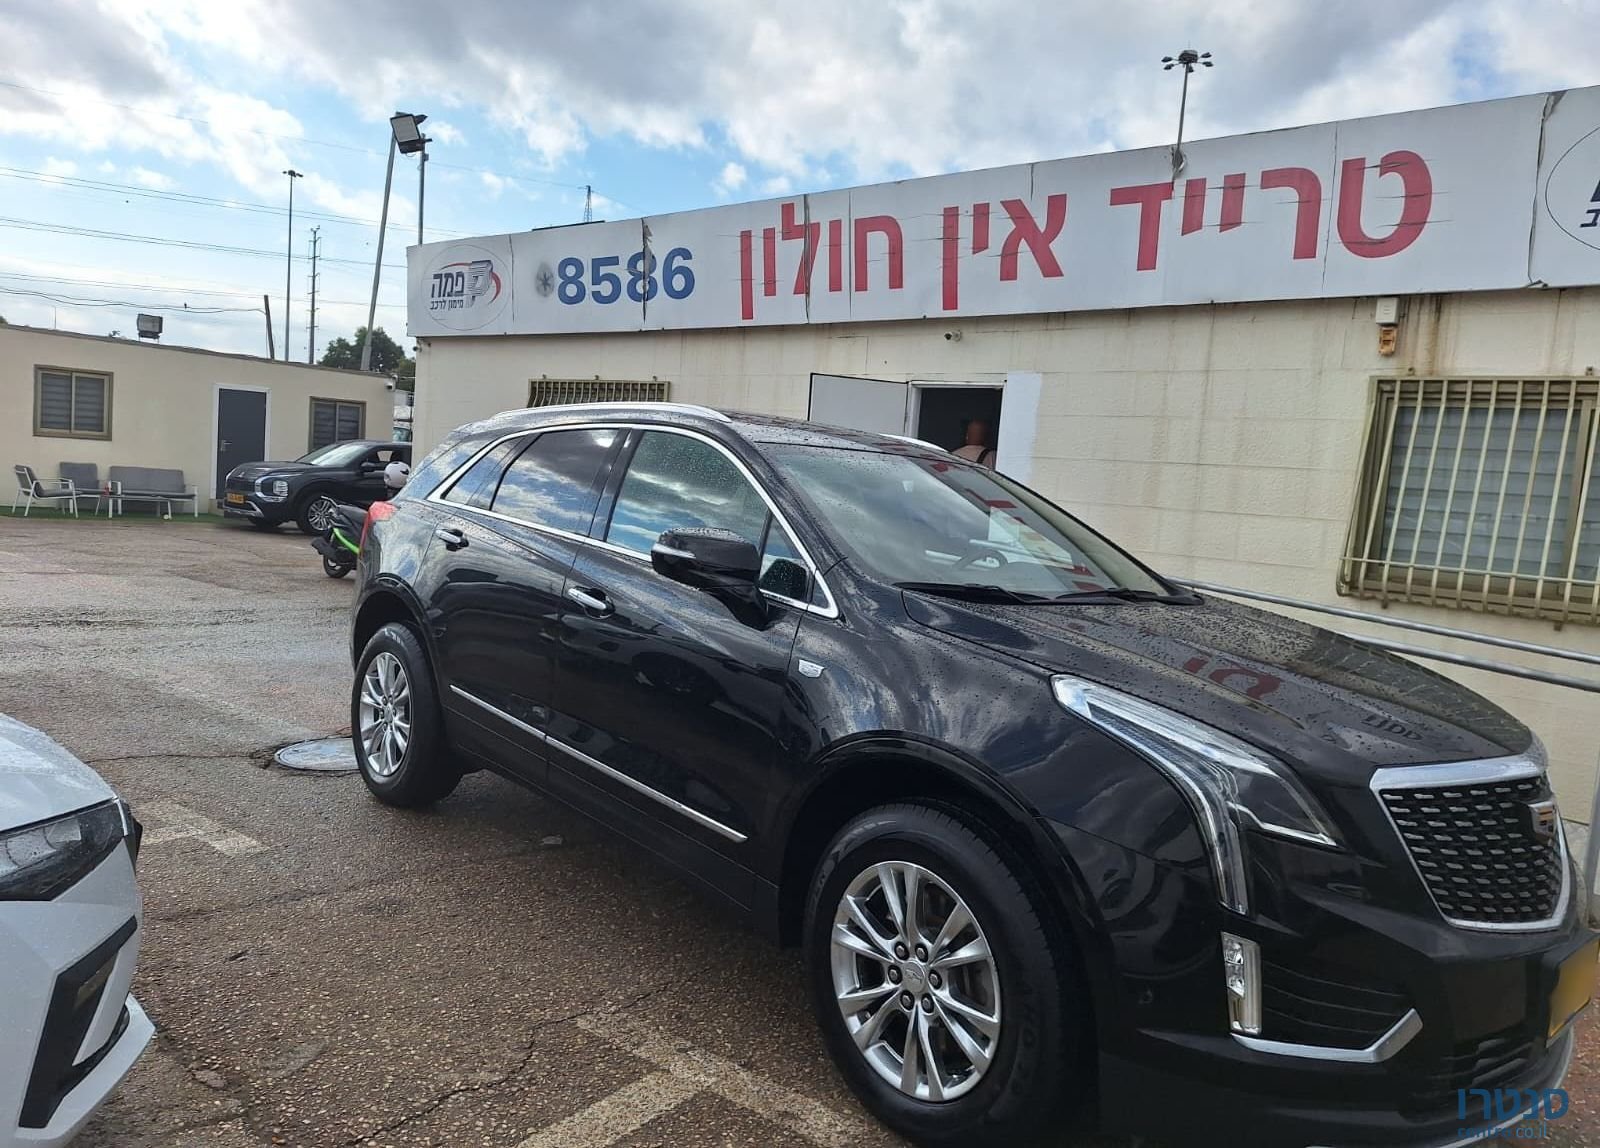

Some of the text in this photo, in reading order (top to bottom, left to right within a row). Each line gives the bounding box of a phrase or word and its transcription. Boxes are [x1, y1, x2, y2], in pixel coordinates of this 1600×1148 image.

[740, 150, 1433, 320] טרייד אין חולון
[431, 271, 465, 298] פמה
